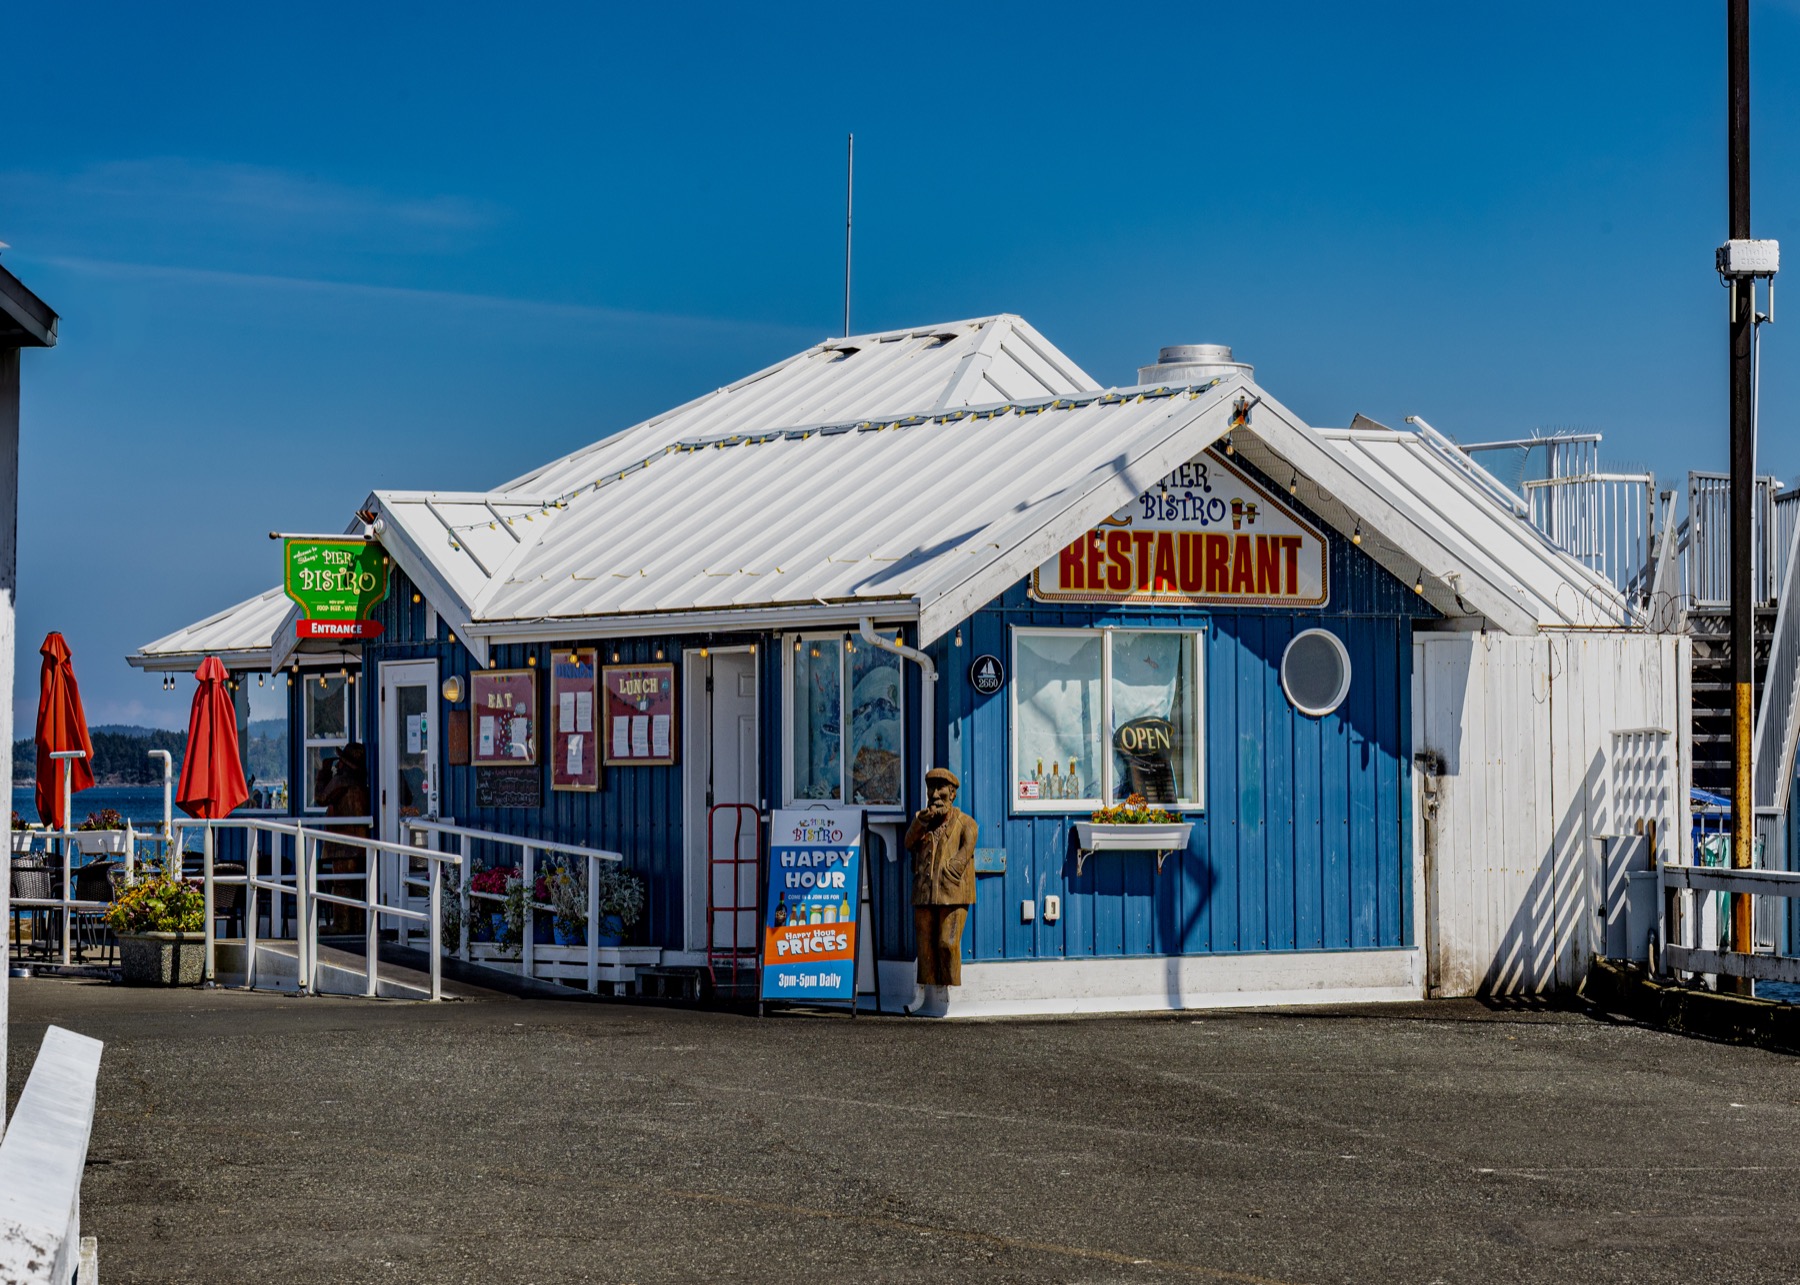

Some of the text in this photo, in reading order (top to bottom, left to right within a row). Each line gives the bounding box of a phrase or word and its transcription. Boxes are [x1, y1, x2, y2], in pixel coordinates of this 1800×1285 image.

[1139, 490, 1226, 526] BISTRO
[322, 549, 353, 566] PIER
[1058, 528, 1303, 595] RESTAURANT
[299, 567, 376, 595] BISTRO
[312, 622, 362, 634] ENTRANCE
[619, 678, 658, 696] LUNCH
[488, 692, 512, 708] EAT
[1122, 726, 1170, 749] OPEN
[792, 827, 843, 844] BISTRO
[780, 851, 854, 867] HAPPY
[785, 872, 846, 888] HOUR
[777, 934, 848, 956] PRICES
[778, 973, 841, 988] 3pm-5pm Daily
